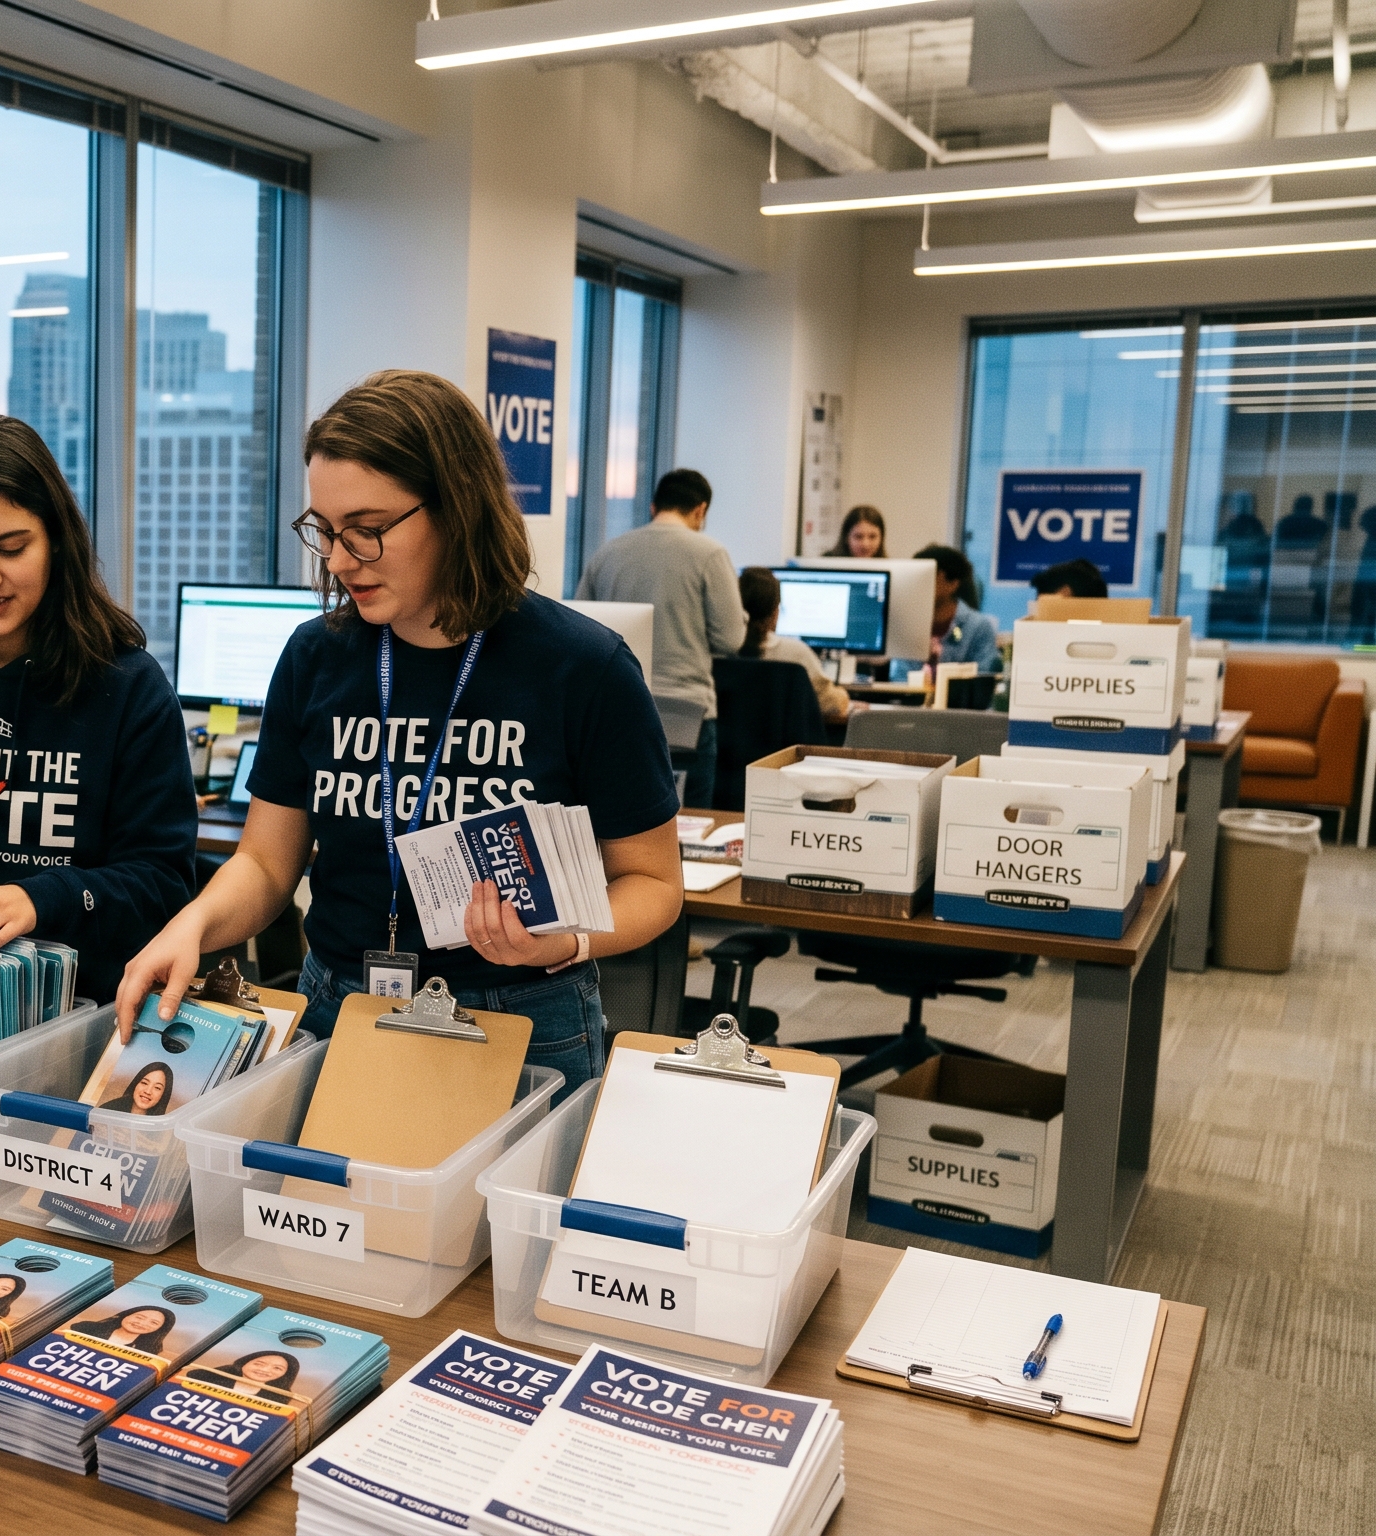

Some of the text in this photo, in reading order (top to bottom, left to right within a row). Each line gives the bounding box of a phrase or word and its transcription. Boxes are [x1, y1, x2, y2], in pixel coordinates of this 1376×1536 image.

[488, 392, 552, 444] VOTE
[1006, 508, 1131, 542] VOTE
[1043, 675, 1135, 695] SUPPLIES
[332, 716, 525, 766] VOTE FOR
[27, 751, 81, 784] THE
[790, 830, 863, 852] FLYERS
[997, 836, 1063, 857] DOOR
[33, 856, 71, 867] VOICE
[976, 860, 1082, 885] HANGERS
[4, 1148, 93, 1187] DISTRICT
[100, 1173, 113, 1191] 4
[908, 1156, 1000, 1188] SUPPLIES
[258, 1206, 350, 1243] WARD 7
[572, 1270, 676, 1310] TEAM B
[28, 1353, 121, 1392] CHEN
[44, 1341, 138, 1378] CHLOE
[464, 1345, 558, 1387] VOTE
[445, 1361, 540, 1400] CHLOE
[605, 1362, 796, 1425] VOTE FOR
[150, 1404, 252, 1446] CHEN
[165, 1390, 269, 1430] CHLOE
[580, 1402, 619, 1420] YOUR
[686, 1434, 726, 1449] YOUR
[590, 1381, 790, 1442] CHLOE CHEN
